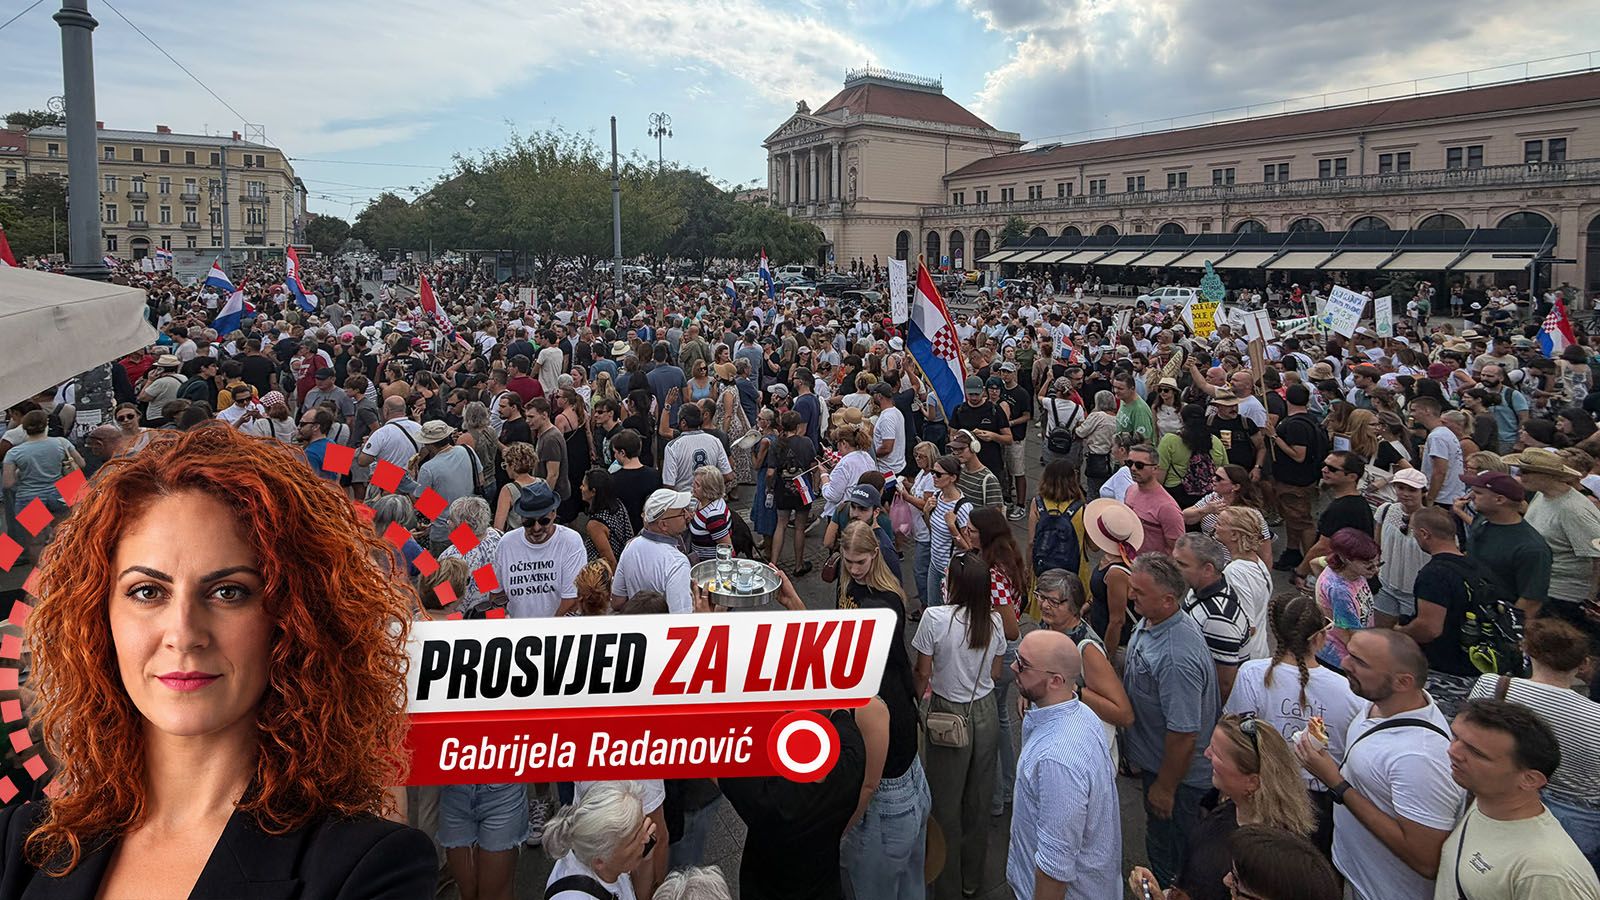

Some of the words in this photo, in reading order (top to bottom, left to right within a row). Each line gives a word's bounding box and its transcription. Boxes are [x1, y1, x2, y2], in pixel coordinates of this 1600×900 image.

[693, 448, 708, 472] 8
[510, 560, 554, 573] OČISTIMO
[510, 572, 557, 585] HRVATSKU
[510, 588, 524, 596] OD
[1281, 698, 1327, 718] Can't
